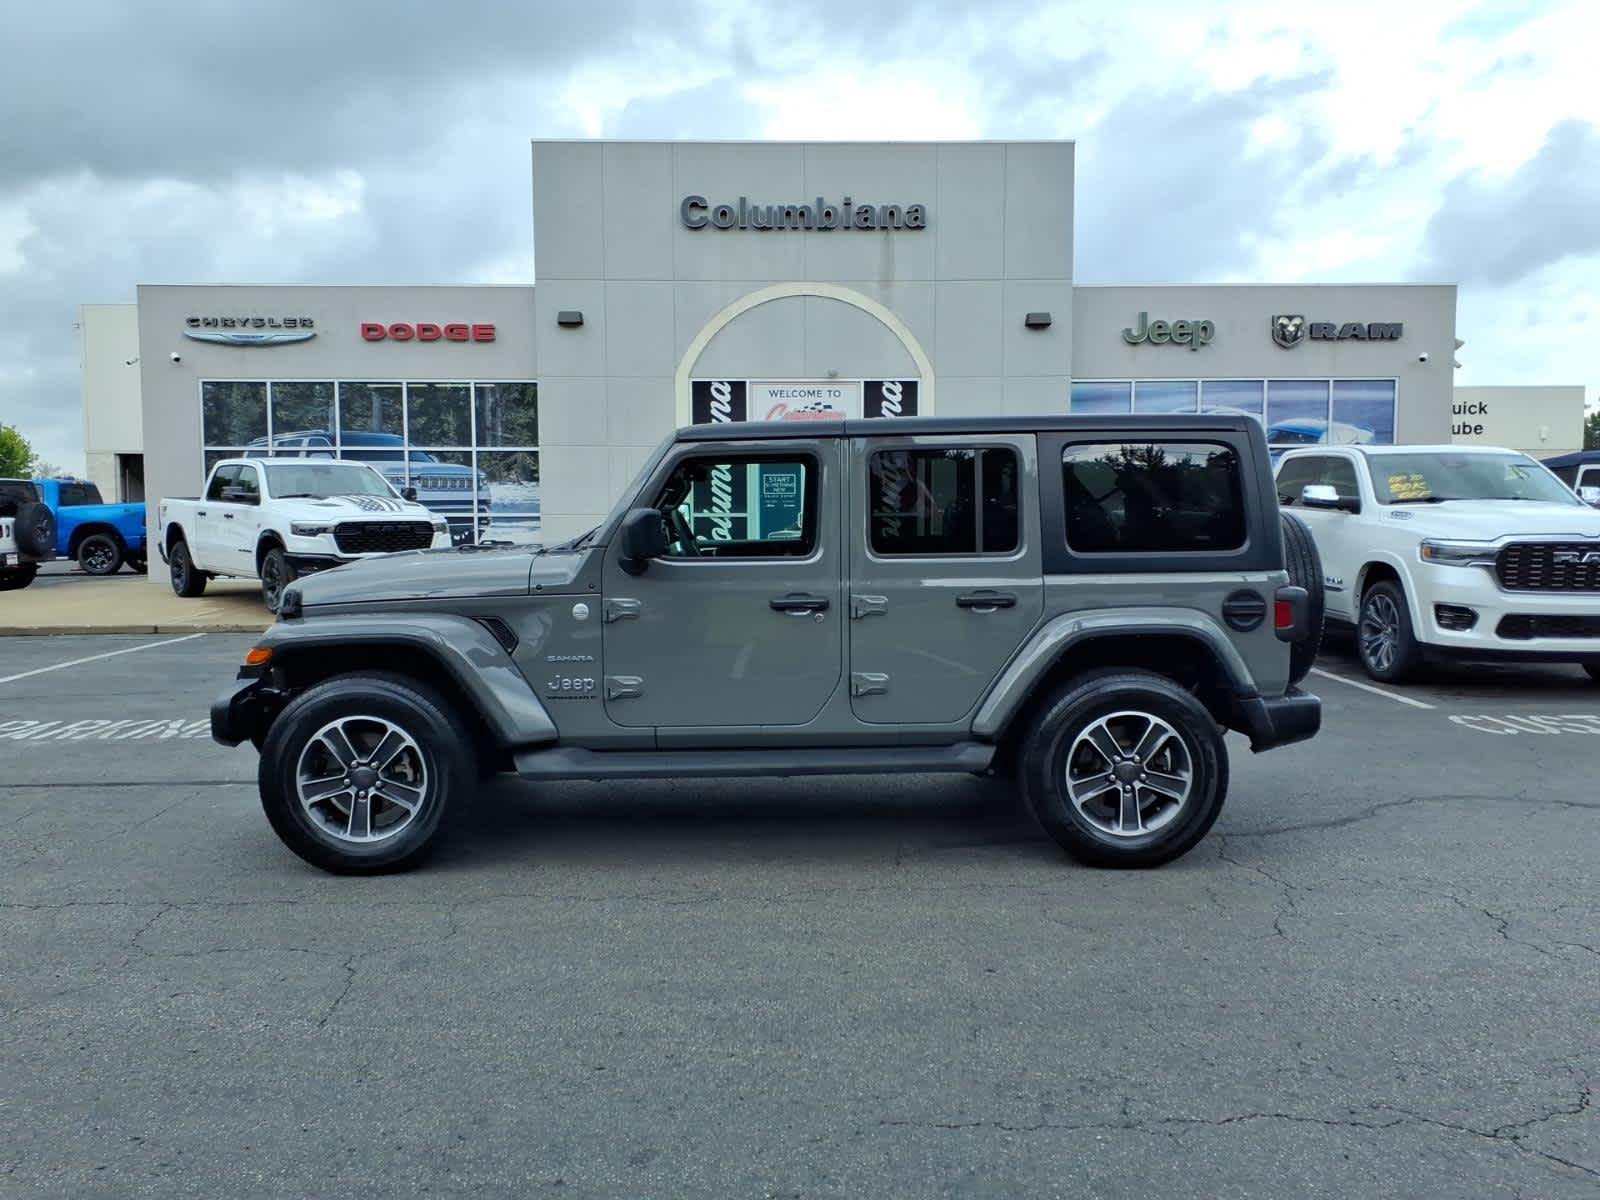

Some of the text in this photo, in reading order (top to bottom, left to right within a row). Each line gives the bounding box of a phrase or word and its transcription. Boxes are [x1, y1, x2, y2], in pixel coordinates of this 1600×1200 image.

[680, 195, 927, 229] Columbiana
[186, 316, 315, 328] CHRYSLER
[1122, 311, 1216, 351] Jeep
[1310, 322, 1404, 341] RAM
[361, 322, 496, 342] DODGE
[768, 389, 841, 398] WELCOME TO
[547, 674, 595, 692] Jeep
